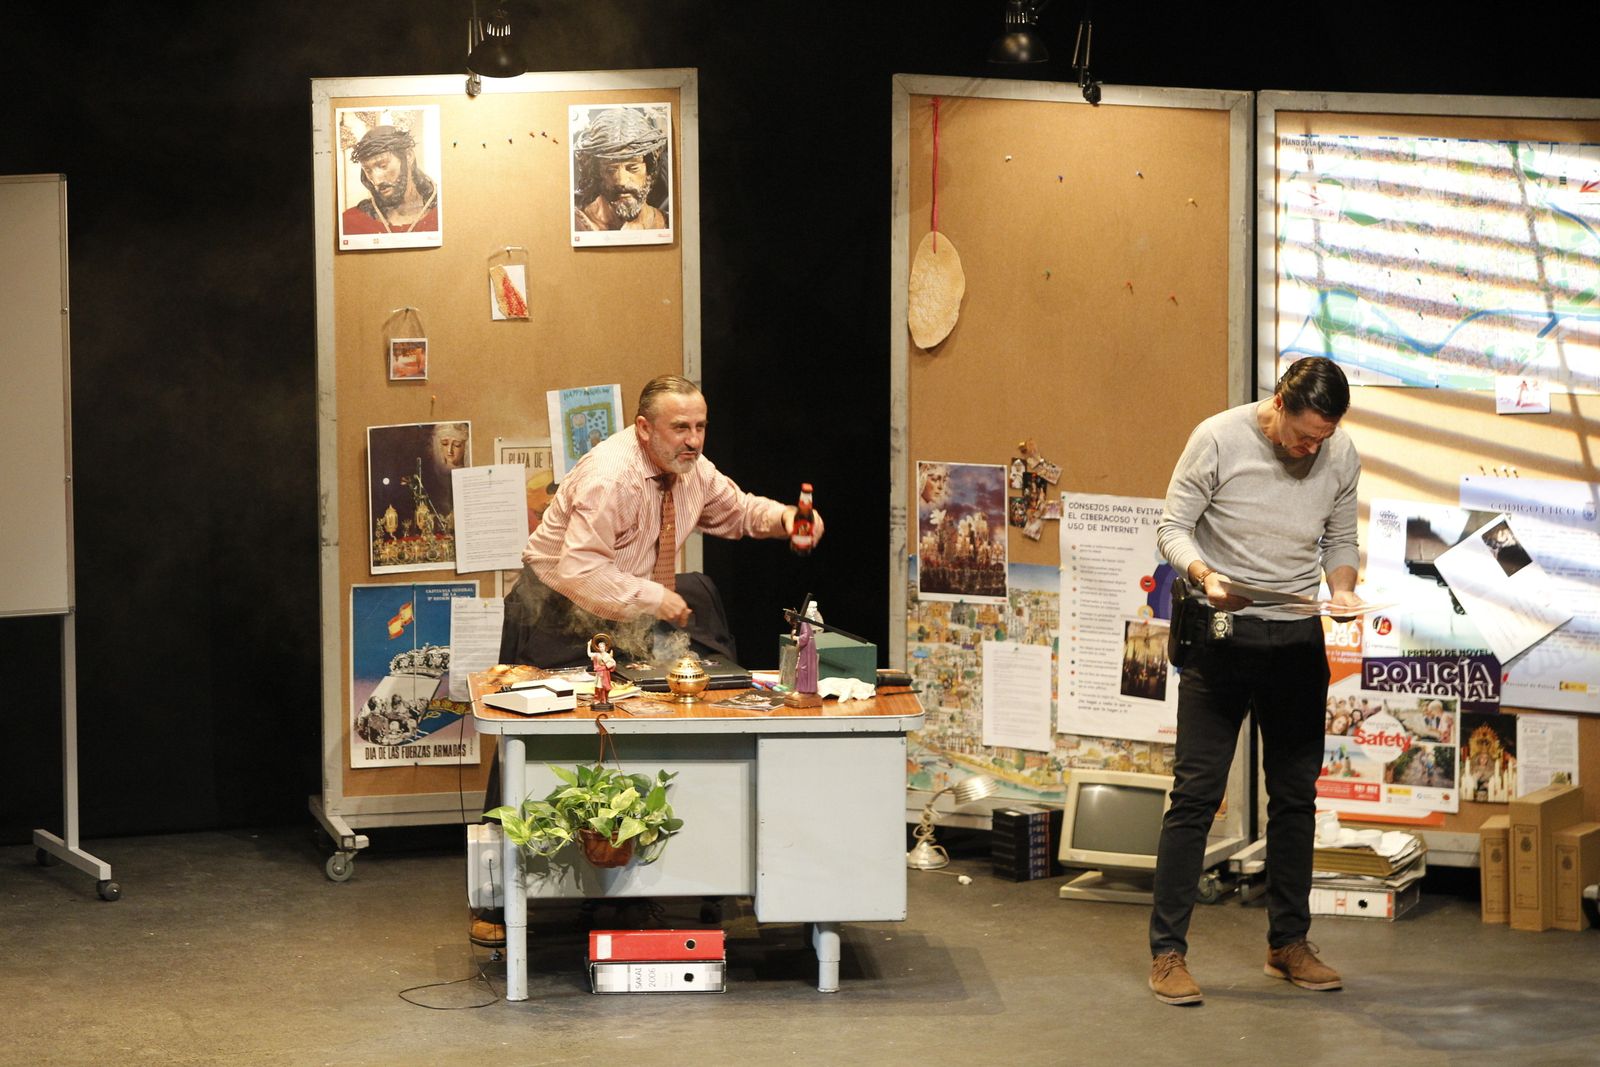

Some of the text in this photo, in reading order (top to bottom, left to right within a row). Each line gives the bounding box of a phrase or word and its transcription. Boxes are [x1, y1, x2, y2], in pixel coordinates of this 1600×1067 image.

[1068, 501, 1110, 513] CONSEJOS
[1112, 504, 1134, 514] PARA
[1067, 511, 1077, 520] EL
[1080, 513, 1131, 525] CIBERACOSO
[1132, 516, 1139, 525] Y
[1141, 518, 1151, 526] EL
[1067, 522, 1139, 535] USO DE INTERNET
[1444, 649, 1457, 657] DE
[1377, 681, 1499, 702] NACIONAL
[1354, 727, 1412, 752] Safety
[378, 747, 386, 759] DE
[388, 746, 400, 759] LAS
[401, 744, 431, 759] FUERZAS
[433, 743, 467, 758] ARMADAS
